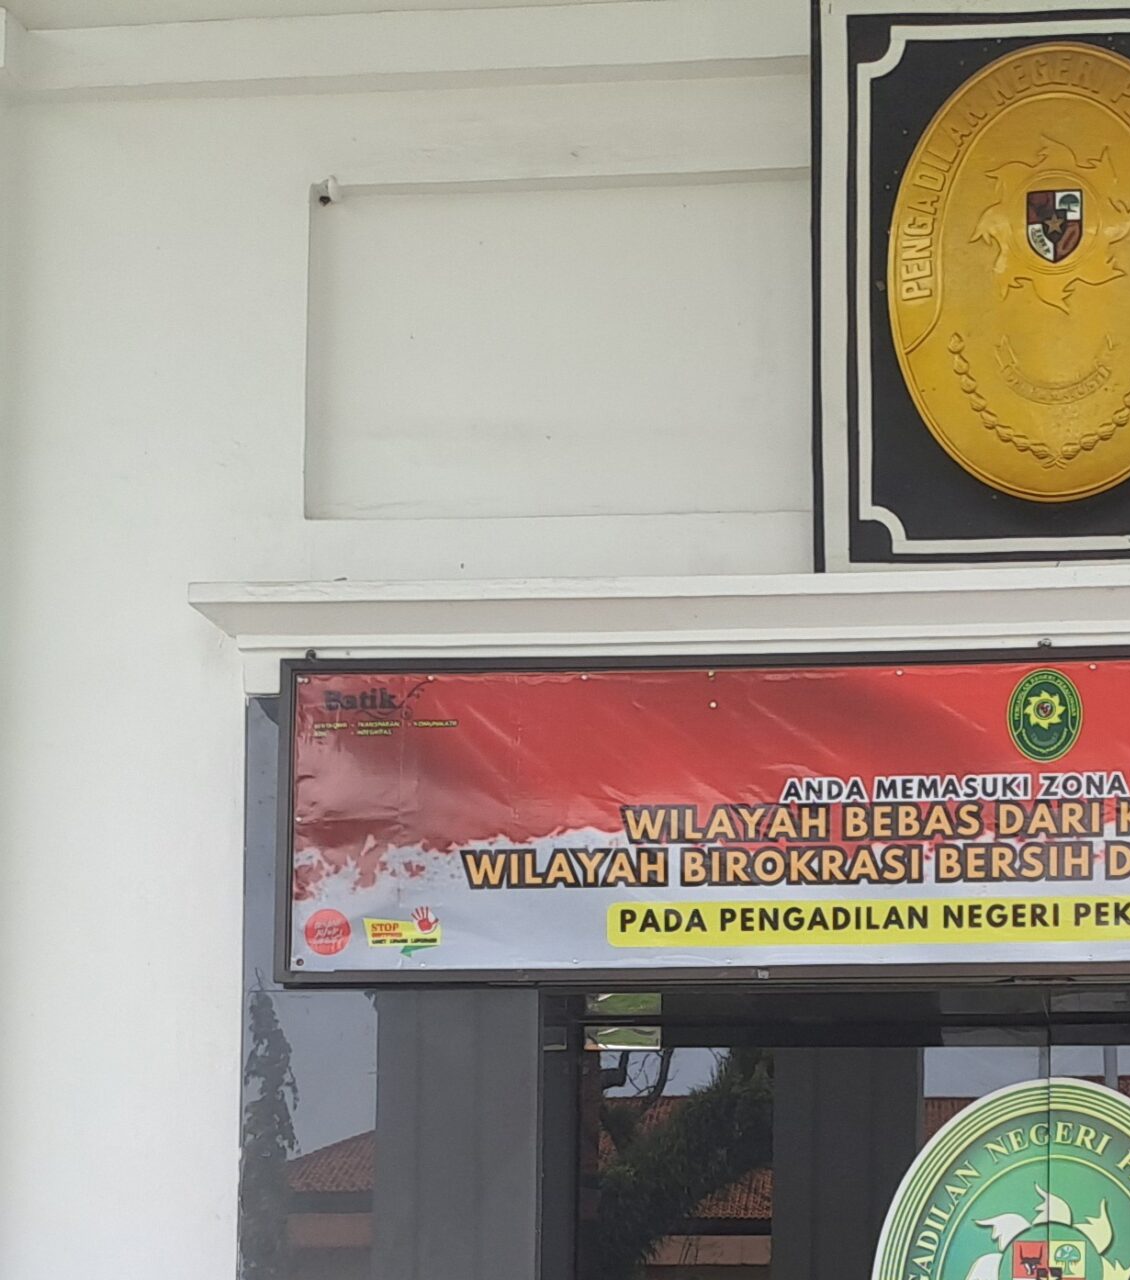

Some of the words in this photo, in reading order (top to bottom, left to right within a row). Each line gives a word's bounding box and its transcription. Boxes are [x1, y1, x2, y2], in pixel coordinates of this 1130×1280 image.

[902, 105, 987, 302] PENGADILAN
[997, 54, 1100, 107] NEGERI
[324, 687, 398, 711] Batik
[783, 777, 865, 803] ANDA
[875, 774, 1030, 801] MEMASUKI
[1041, 773, 1126, 798] ZONA
[624, 805, 827, 842] WILAYAH
[845, 802, 982, 839] BEBAS
[1000, 800, 1102, 837] DARI
[464, 850, 666, 887] WILAYAH
[682, 844, 924, 886] BIROKRASI
[938, 843, 1092, 880] BERSIH
[370, 923, 400, 932] STOP
[619, 908, 706, 933] PADA
[719, 904, 929, 932] PENGADILAN
[942, 902, 1060, 930] NEGERI
[984, 1121, 1112, 1164] NEGERI
